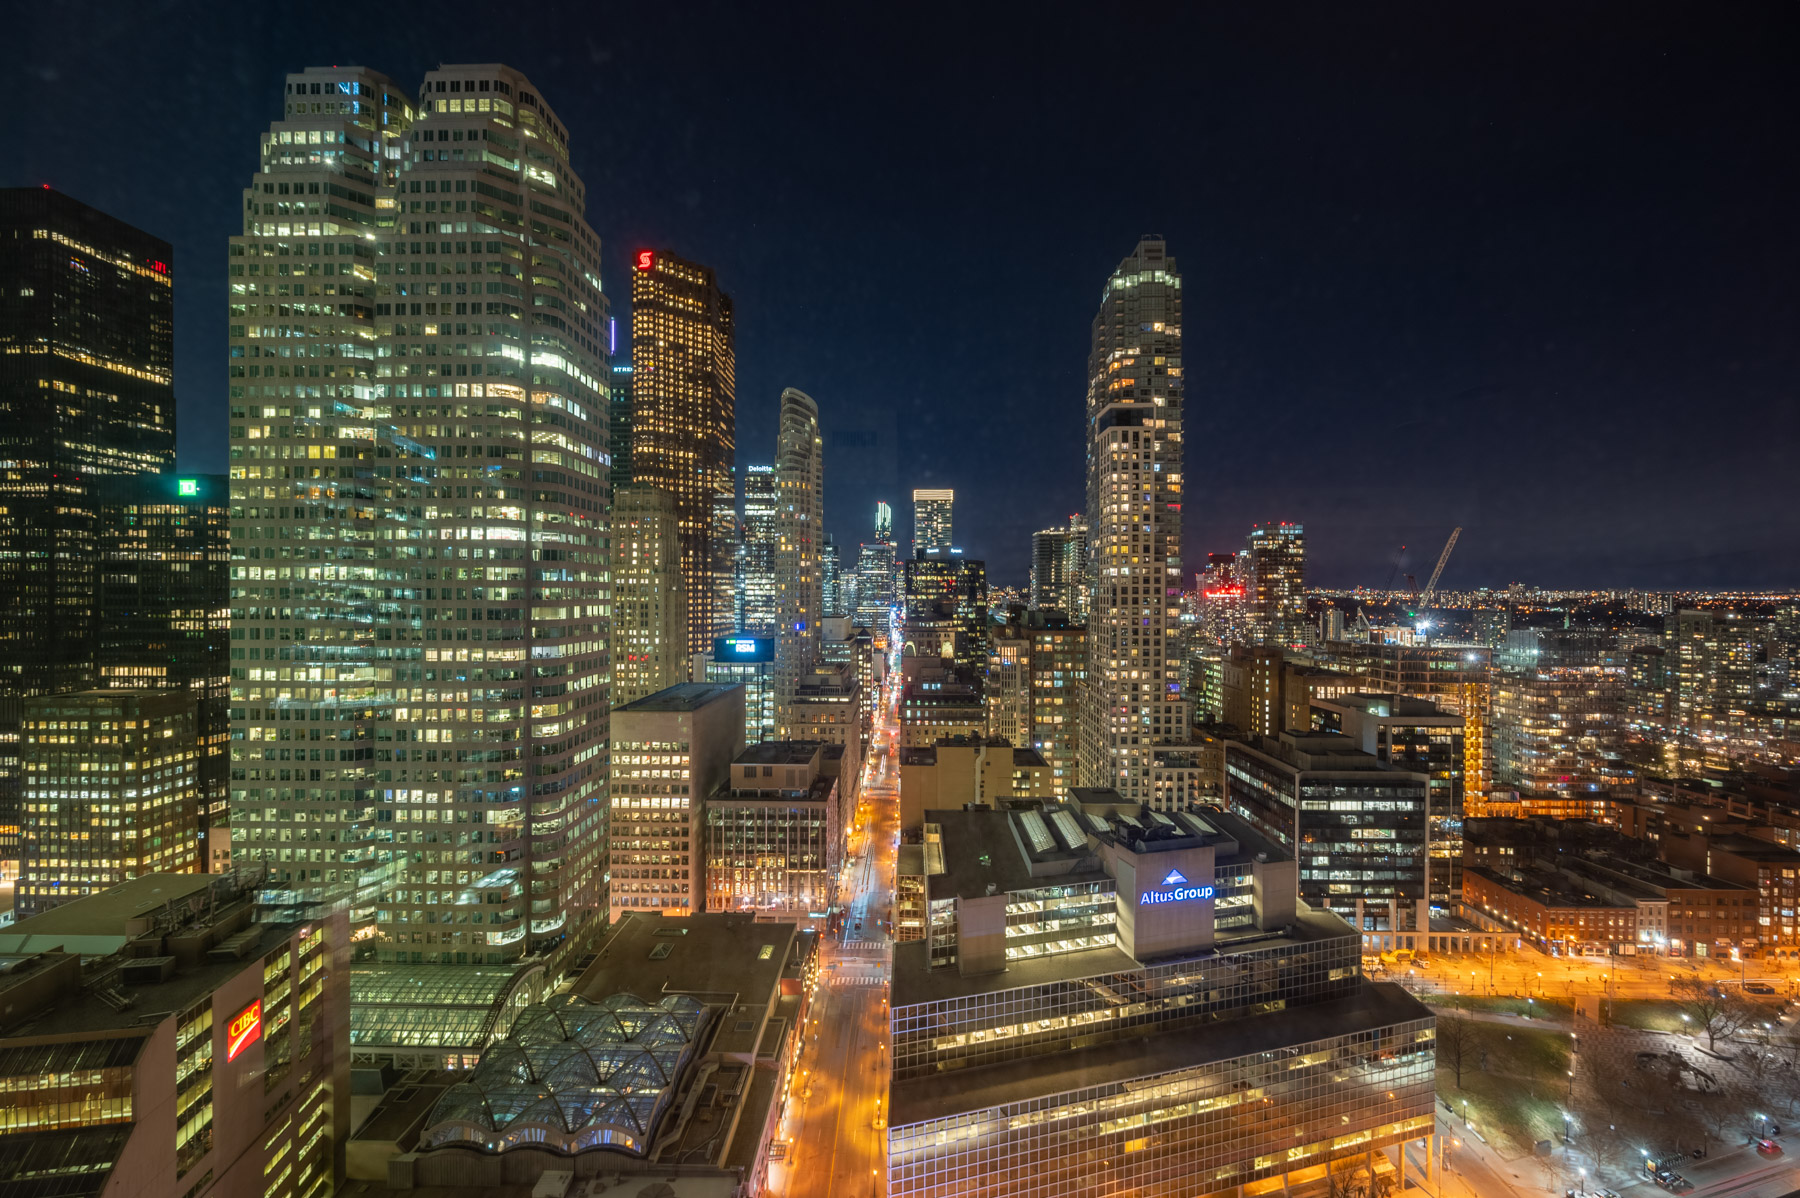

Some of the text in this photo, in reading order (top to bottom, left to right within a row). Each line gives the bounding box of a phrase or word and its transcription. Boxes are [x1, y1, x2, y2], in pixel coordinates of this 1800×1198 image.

[180, 482, 195, 493] TD
[735, 643, 756, 653] RSM
[1140, 886, 1213, 905] AltusGroup
[230, 1005, 259, 1037] CIBC
